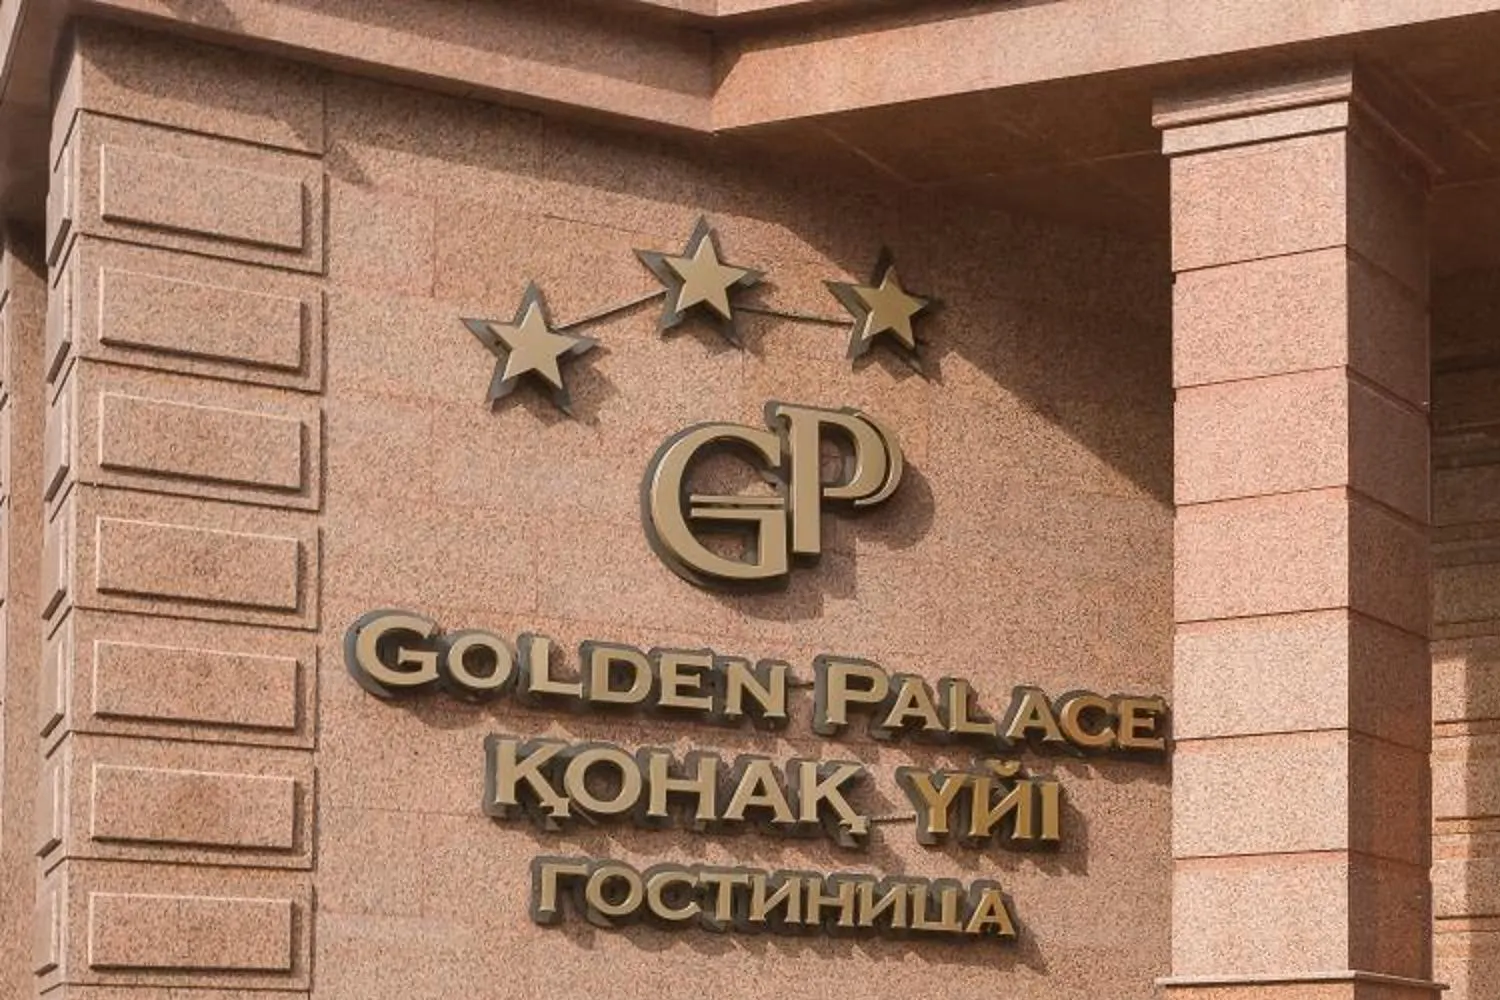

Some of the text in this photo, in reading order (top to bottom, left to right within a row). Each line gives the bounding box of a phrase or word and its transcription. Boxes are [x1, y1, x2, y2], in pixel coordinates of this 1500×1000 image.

[647, 402, 904, 582] GP
[349, 609, 1166, 752] GOLDEN PALACE
[490, 735, 873, 837] ҚОНАҚ
[536, 860, 1018, 938] ГОСТИНИЦА
